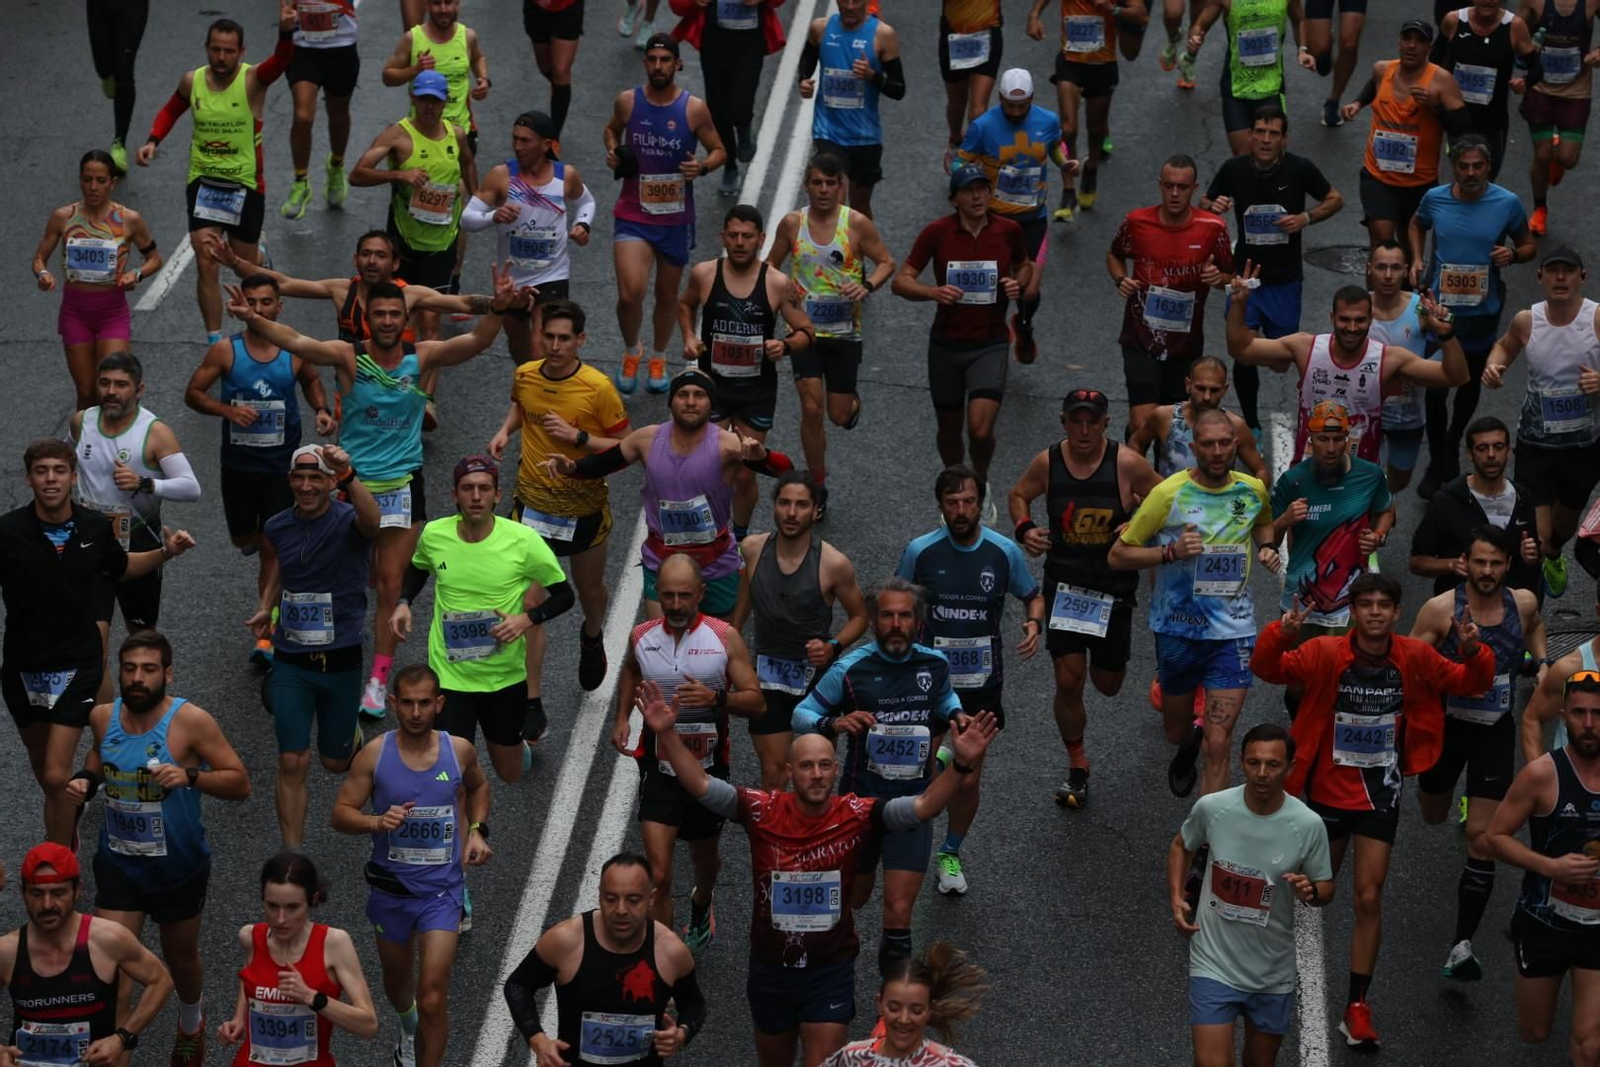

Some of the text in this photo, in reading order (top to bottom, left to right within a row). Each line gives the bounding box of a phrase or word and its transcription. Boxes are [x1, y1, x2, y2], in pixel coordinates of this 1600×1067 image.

[418, 189, 448, 208] 6297
[647, 182, 676, 198] 3906
[74, 249, 105, 264] 3403
[955, 271, 986, 286] 1930
[1446, 275, 1478, 289] 5303
[812, 303, 844, 318] 2268
[1154, 298, 1185, 315] 1633
[1548, 399, 1582, 414] 1508
[1308, 504, 1333, 513] AMEDA
[667, 511, 700, 527] 1730
[1204, 556, 1238, 575] 2431
[286, 605, 320, 622] 2932
[1062, 596, 1098, 616] 2597
[450, 623, 489, 641] 3398
[947, 650, 979, 666] 368
[1343, 728, 1382, 746] 2442
[875, 739, 915, 757] 2452
[111, 812, 147, 833] 1949
[400, 821, 441, 840] 2666
[1221, 875, 1252, 896] 411
[782, 885, 825, 905] 3198
[256, 1017, 299, 1038] 3394
[27, 1036, 72, 1054] 2174
[591, 1027, 637, 1048] 2525
